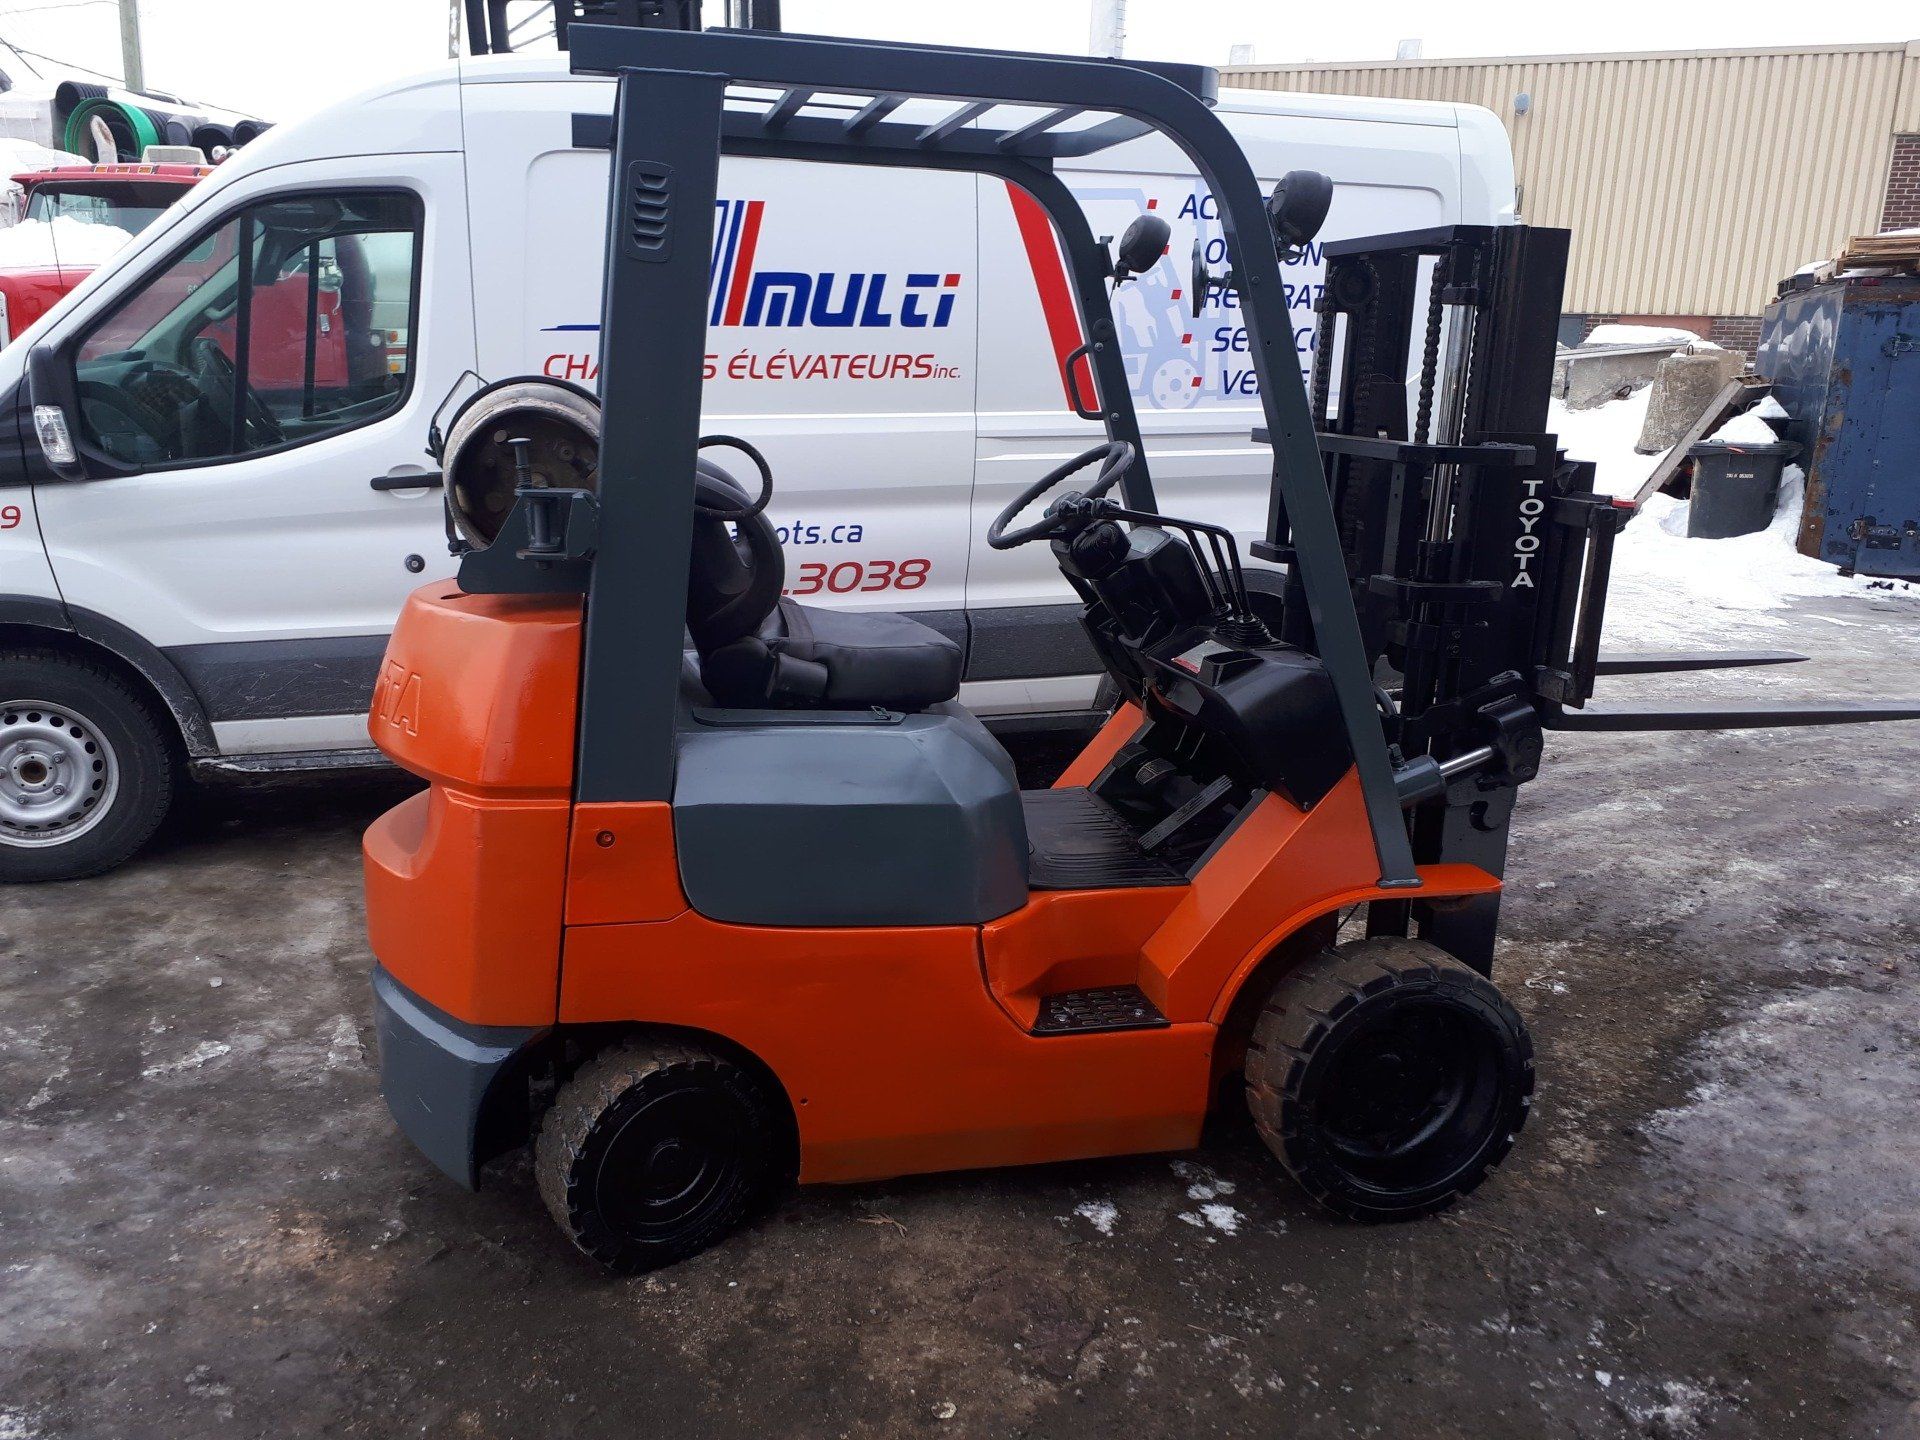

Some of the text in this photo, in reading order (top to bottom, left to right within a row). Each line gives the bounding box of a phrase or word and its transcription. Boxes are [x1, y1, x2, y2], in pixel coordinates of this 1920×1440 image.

[728, 348, 935, 379] ÉLÉVATEURS
[933, 363, 961, 379] inc.
[1511, 480, 1545, 588] TOYOTA
[781, 558, 932, 596] .3038
